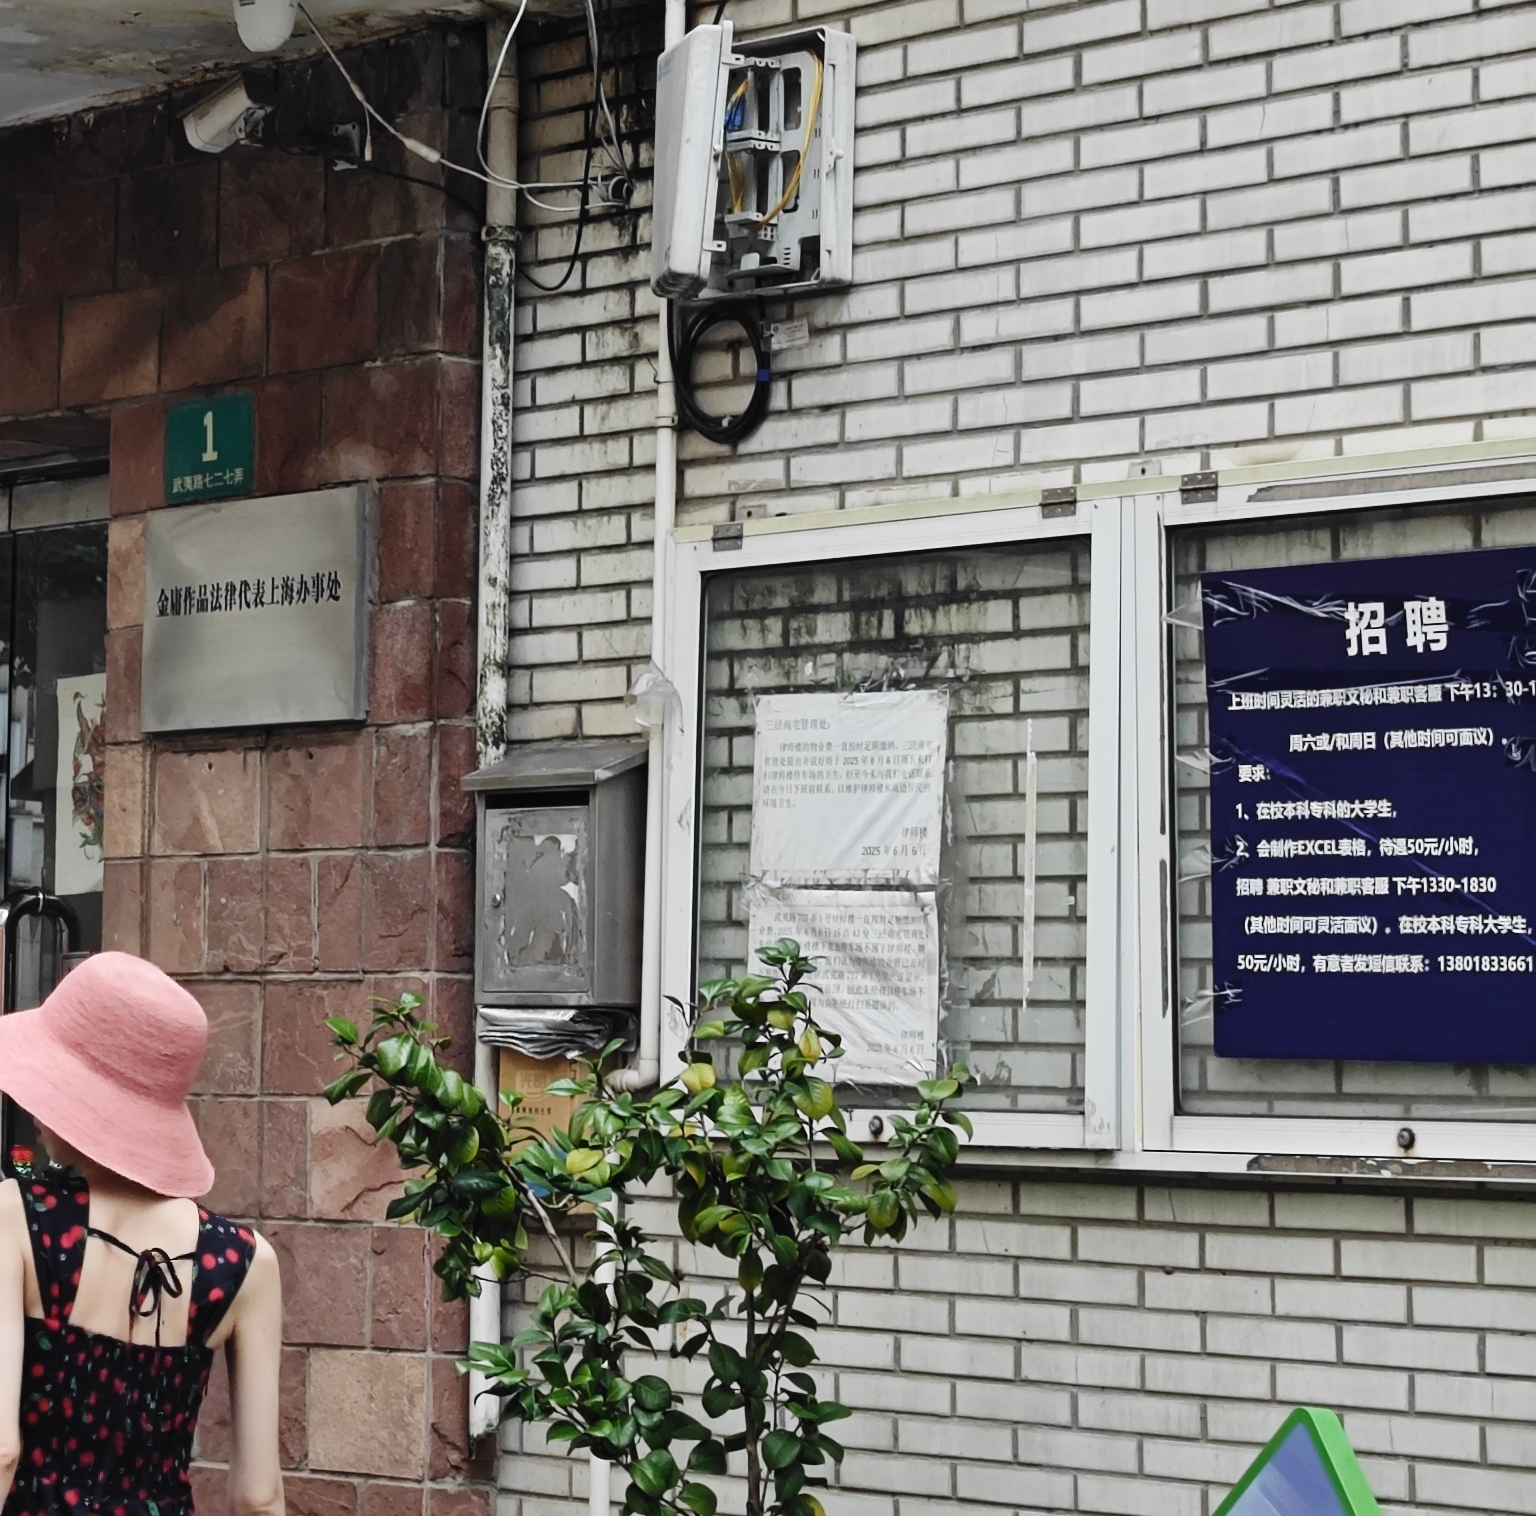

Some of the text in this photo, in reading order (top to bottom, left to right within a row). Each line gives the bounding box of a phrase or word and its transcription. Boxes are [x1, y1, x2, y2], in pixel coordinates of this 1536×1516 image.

[202, 410, 218, 462] 1
[172, 468, 244, 494] 武夷路七二七弄
[156, 570, 342, 618] 金庸作品法律代表上海办事处
[1344, 597, 1449, 656] 招聘
[1228, 685, 1442, 711] 上班时间灵活的兼职文秘和兼职客服
[901, 827, 928, 839] 律师楼
[1236, 876, 1497, 897] 招聘 兼职文秘和兼职客服 下午1330-1830
